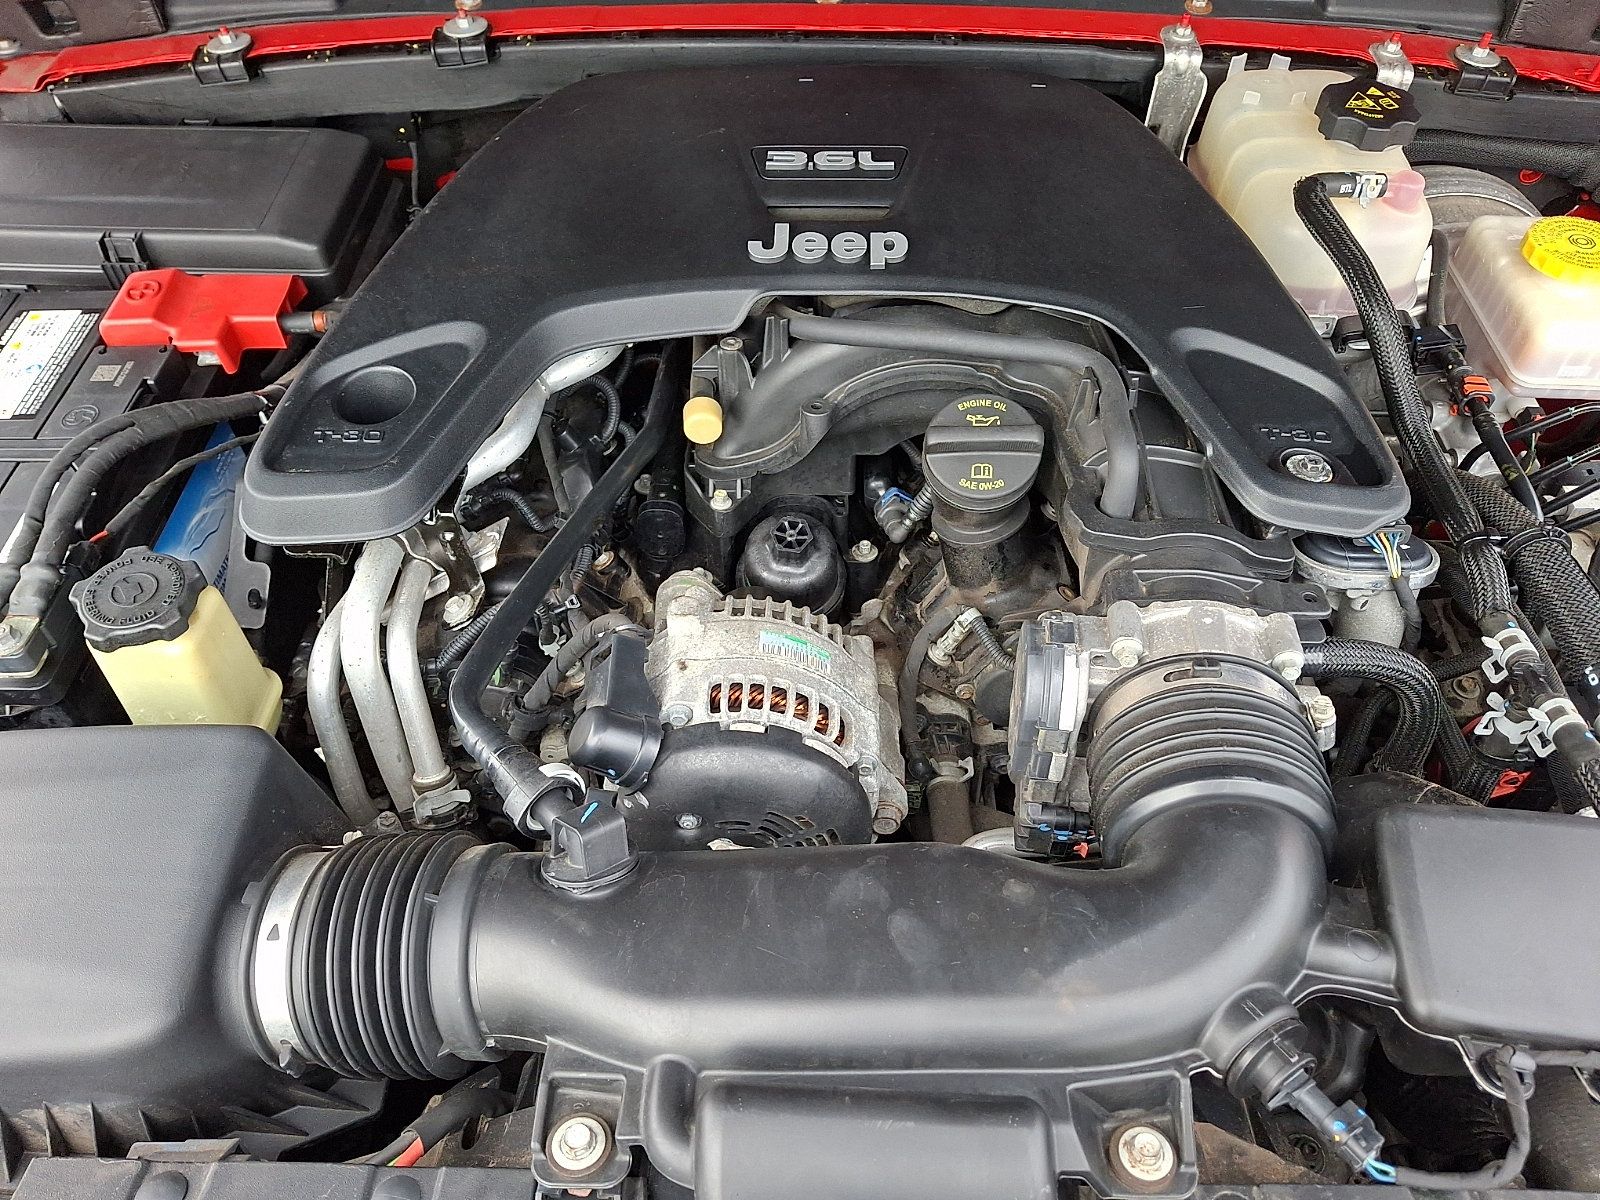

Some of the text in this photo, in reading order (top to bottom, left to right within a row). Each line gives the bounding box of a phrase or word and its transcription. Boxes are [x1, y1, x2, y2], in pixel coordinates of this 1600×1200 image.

[765, 150, 895, 171] 3.6L
[747, 222, 909, 270] Jeep
[957, 398, 1007, 412] ENGINE OIL
[313, 429, 385, 444] T-30
[958, 477, 1005, 491] SAE 0W-20
[141, 555, 183, 606] USE APPROVED
[84, 558, 156, 625] POWER STEERING FLUID
